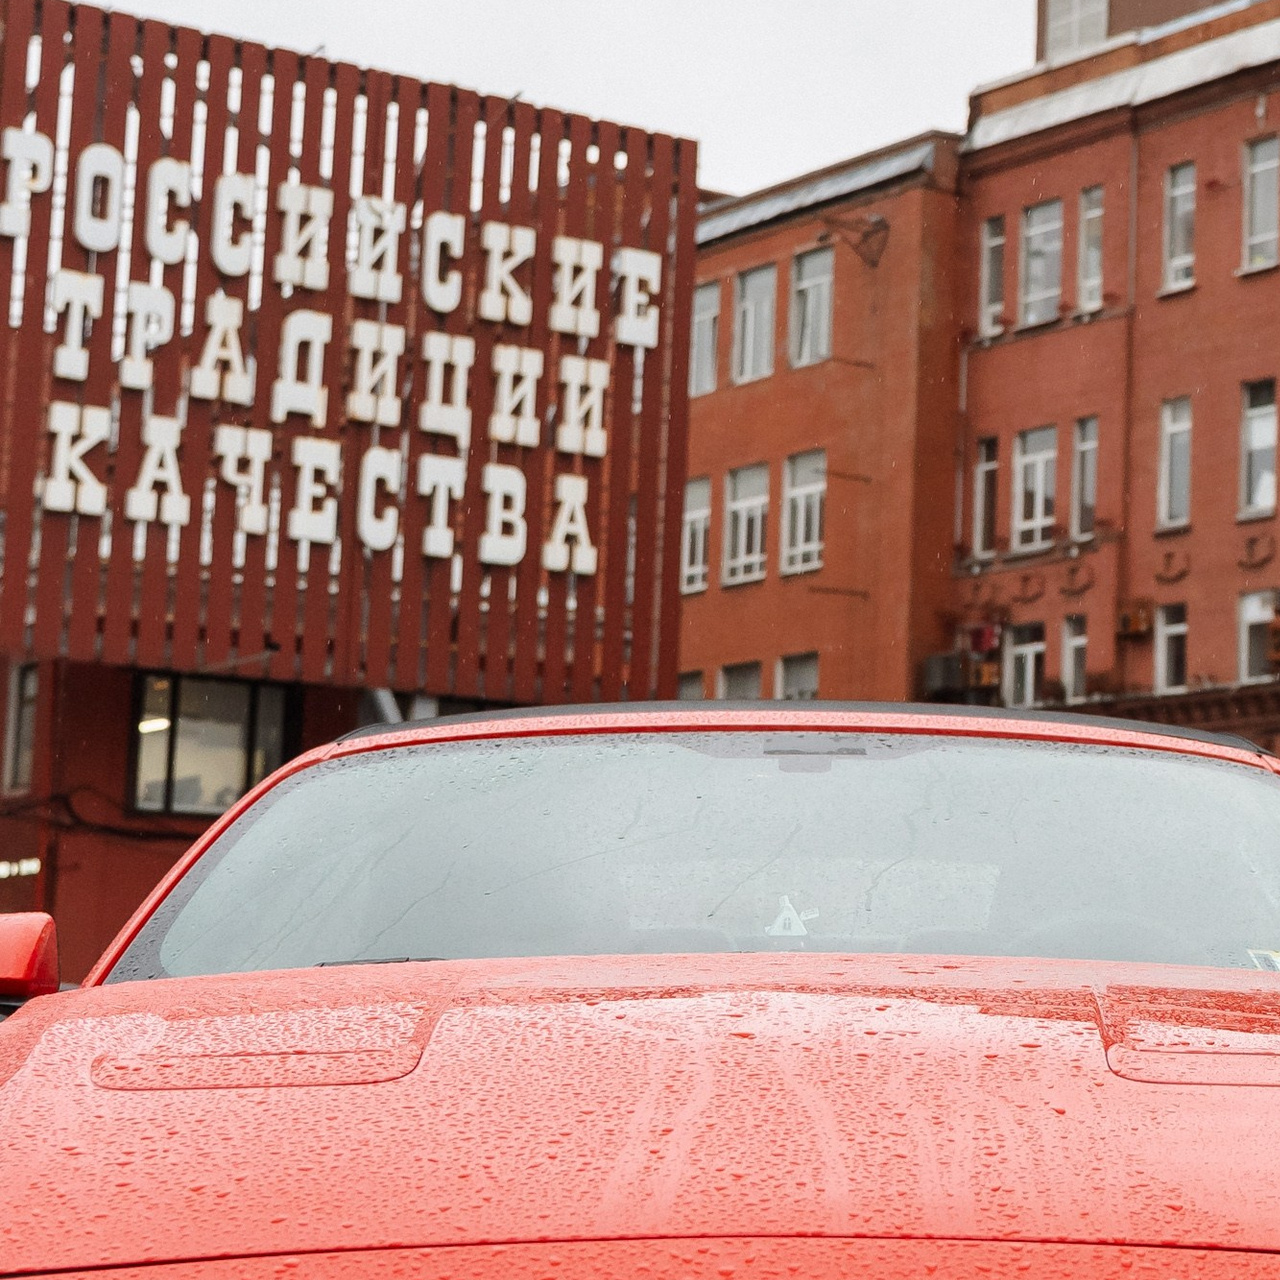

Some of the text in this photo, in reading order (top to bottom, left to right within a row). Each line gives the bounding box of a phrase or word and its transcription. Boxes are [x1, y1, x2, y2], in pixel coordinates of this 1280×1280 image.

[0, 127, 661, 347] РОССИЙСКИЕ
[53, 270, 610, 457] ТРАДИЦИИ
[45, 402, 598, 575] КАЧЕСТВА
